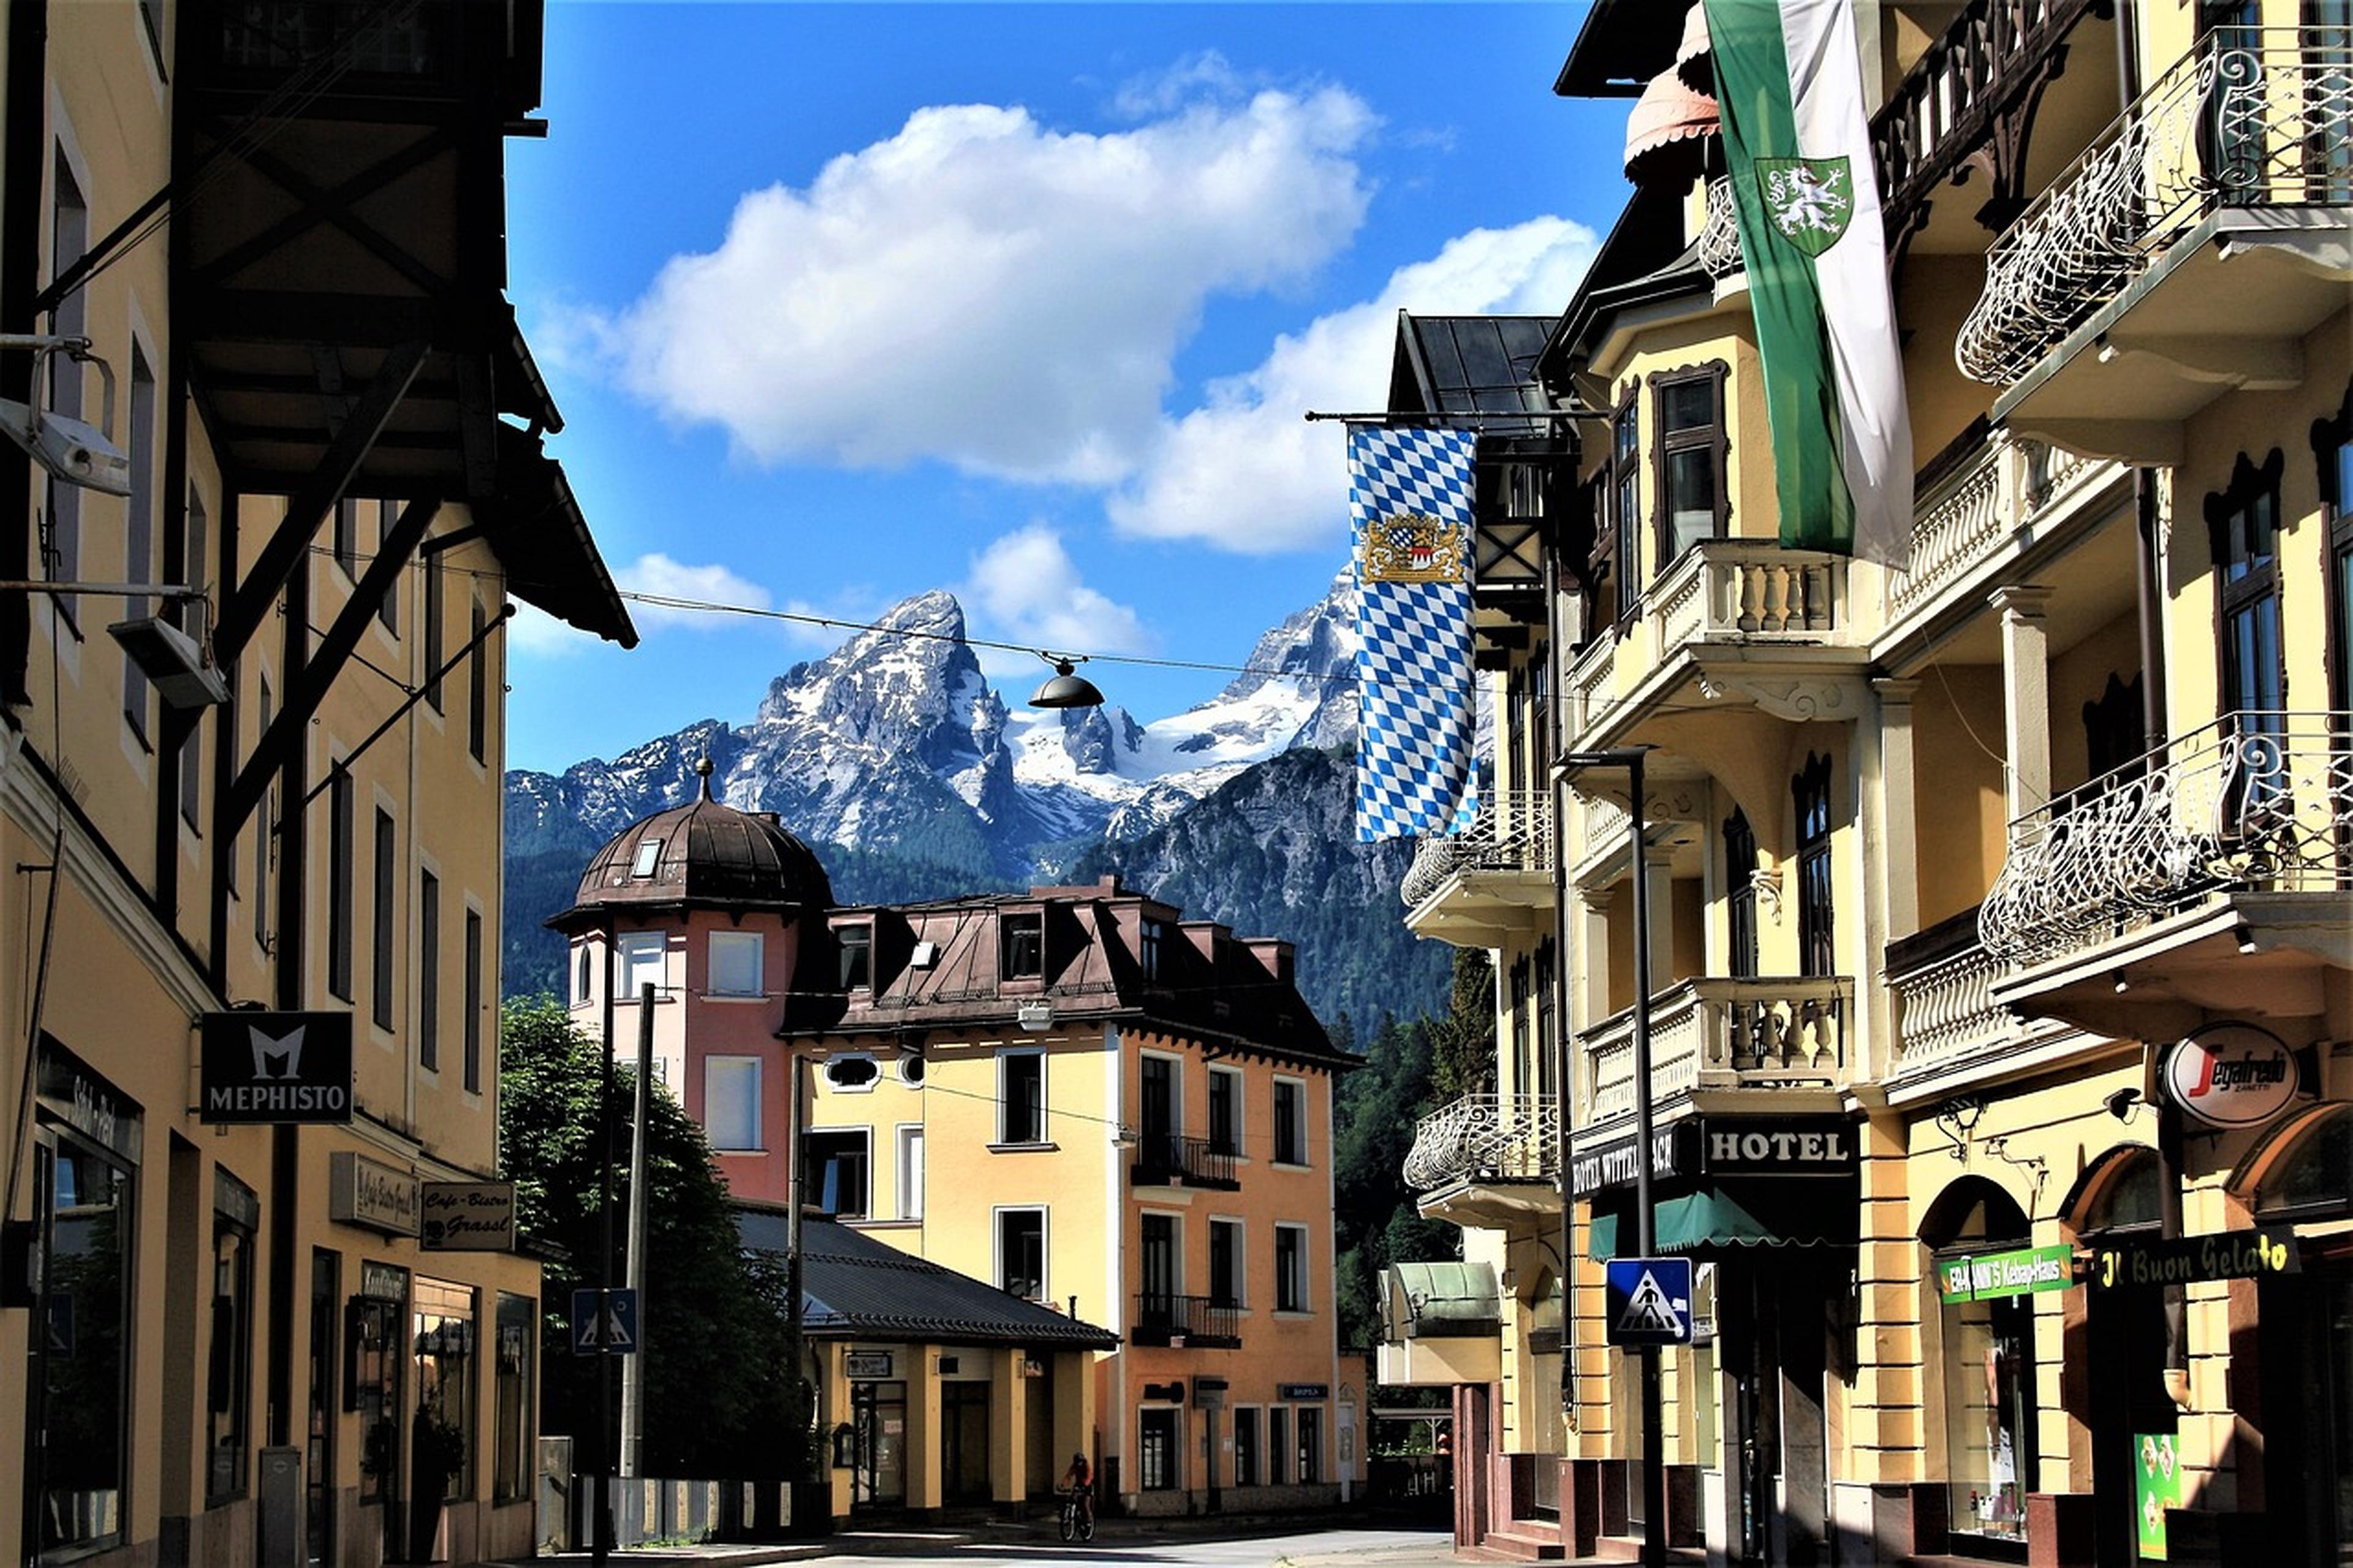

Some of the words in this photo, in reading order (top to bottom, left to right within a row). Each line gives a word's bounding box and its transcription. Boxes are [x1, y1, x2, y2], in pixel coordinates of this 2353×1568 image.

[210, 1086, 345, 1111] MEPHISTO
[1711, 1132, 1848, 1161] HOTEL
[1573, 1156, 1601, 1195] HOTEL
[447, 1214, 509, 1237] Grassl
[2132, 1249, 2194, 1285] Buon
[2201, 1233, 2288, 1279] Gelato
